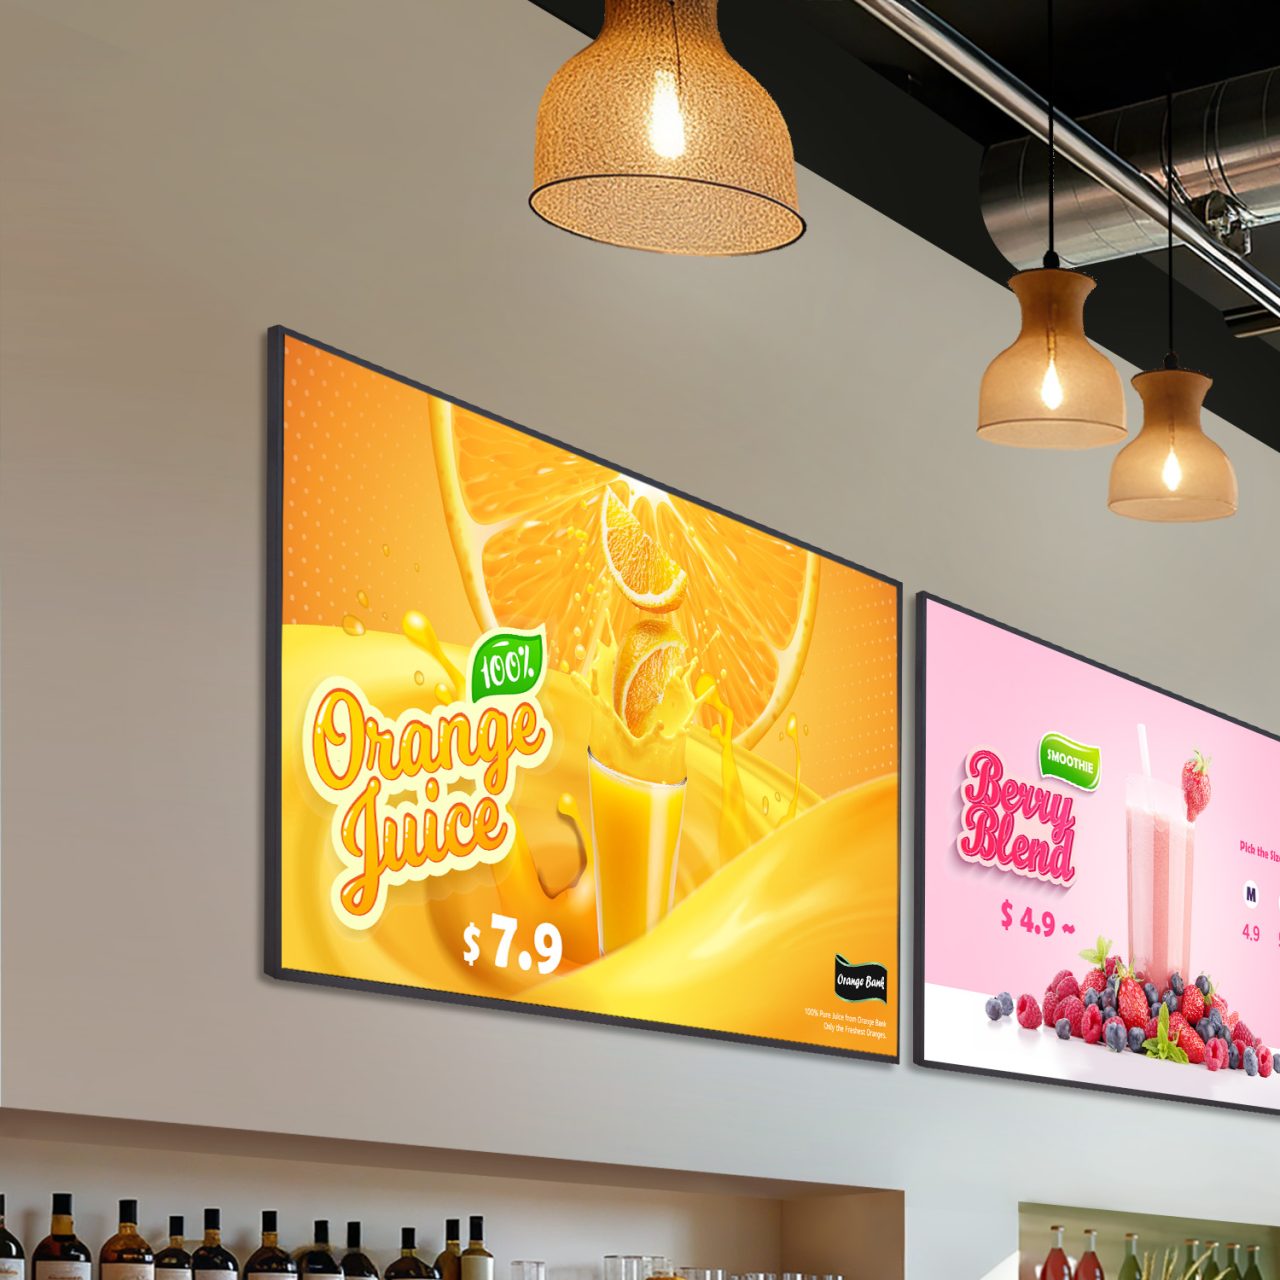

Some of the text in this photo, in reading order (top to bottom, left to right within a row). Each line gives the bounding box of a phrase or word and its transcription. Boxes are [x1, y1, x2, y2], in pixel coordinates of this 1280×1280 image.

[480, 645, 534, 689] 100%
[312, 687, 546, 796] Orange
[1047, 749, 1094, 774] SMOOTHIE
[965, 750, 1076, 845] Berry
[340, 776, 508, 917] Juice
[960, 803, 1075, 882] Blend
[1240, 840, 1256, 855] Pick
[1257, 846, 1269, 859] the
[1246, 886, 1256, 902] M
[491, 913, 563, 975] 7.9
[1242, 923, 1260, 942] 4.9
[837, 973, 885, 990] Orange Bank
